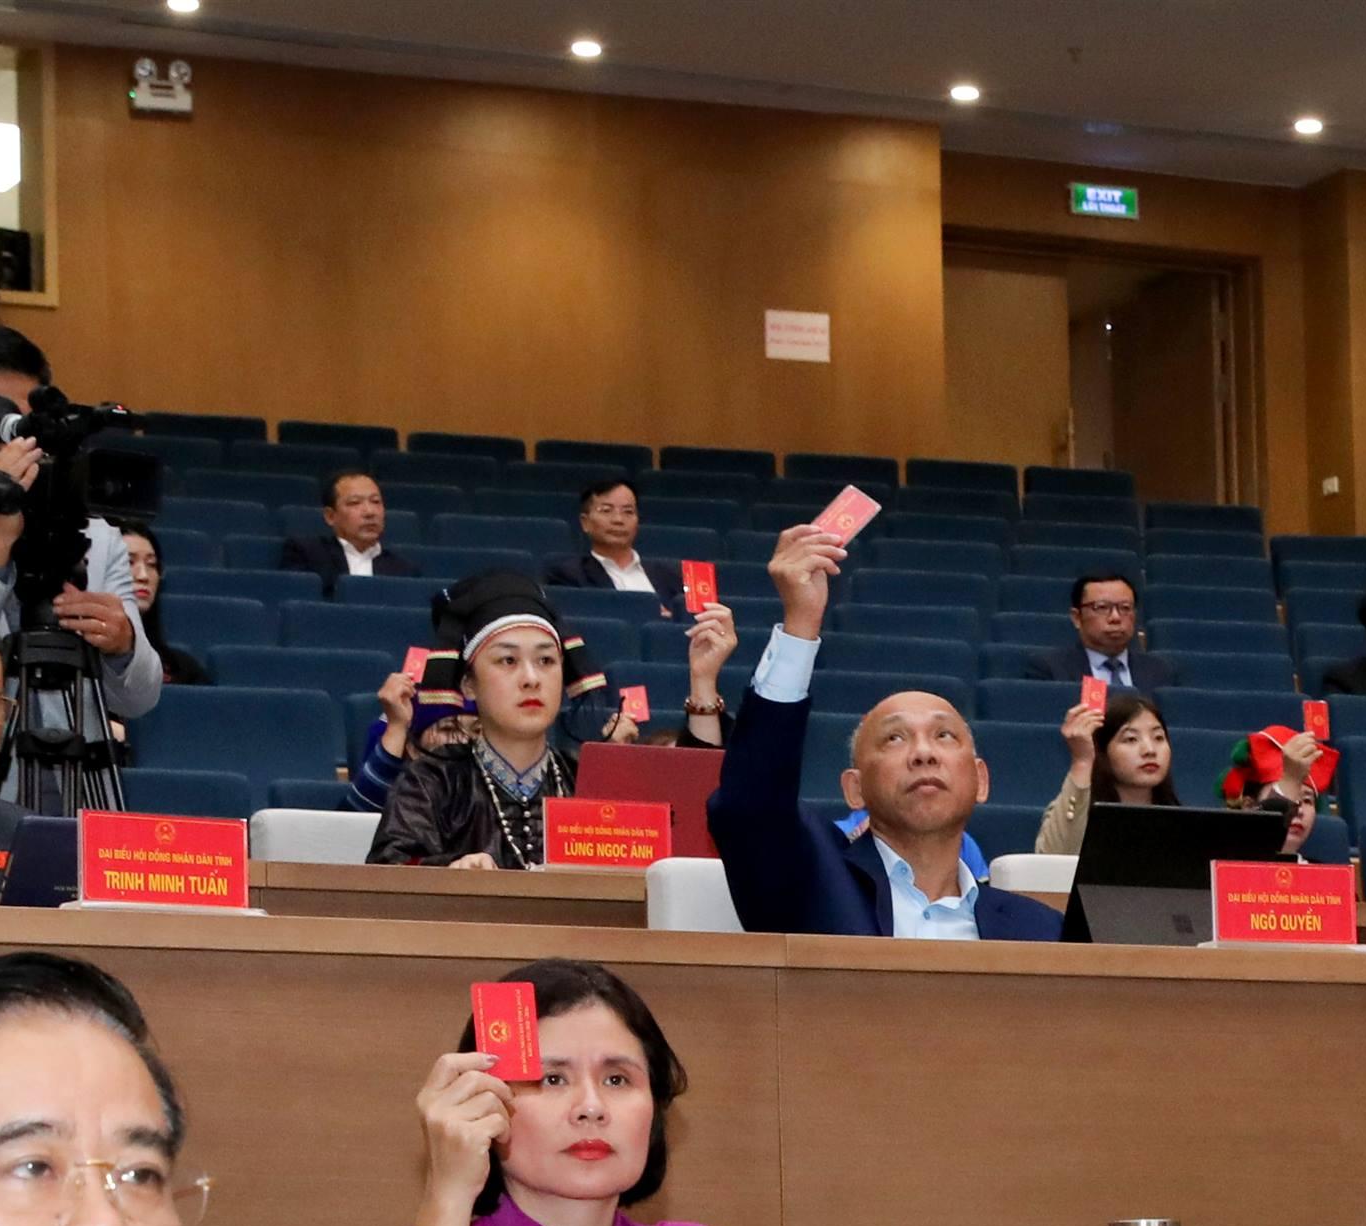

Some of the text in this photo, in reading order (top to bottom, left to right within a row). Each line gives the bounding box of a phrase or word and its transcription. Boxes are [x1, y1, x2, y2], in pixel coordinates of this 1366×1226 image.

[1086, 187, 1122, 203] EXIT
[565, 838, 653, 862] LÙNG NGỌC ÁNH
[104, 871, 144, 895] TRỊNH
[149, 874, 184, 893] MINH
[189, 870, 228, 896] TUẤN
[1251, 907, 1321, 931] NGÔ QUYỀN
